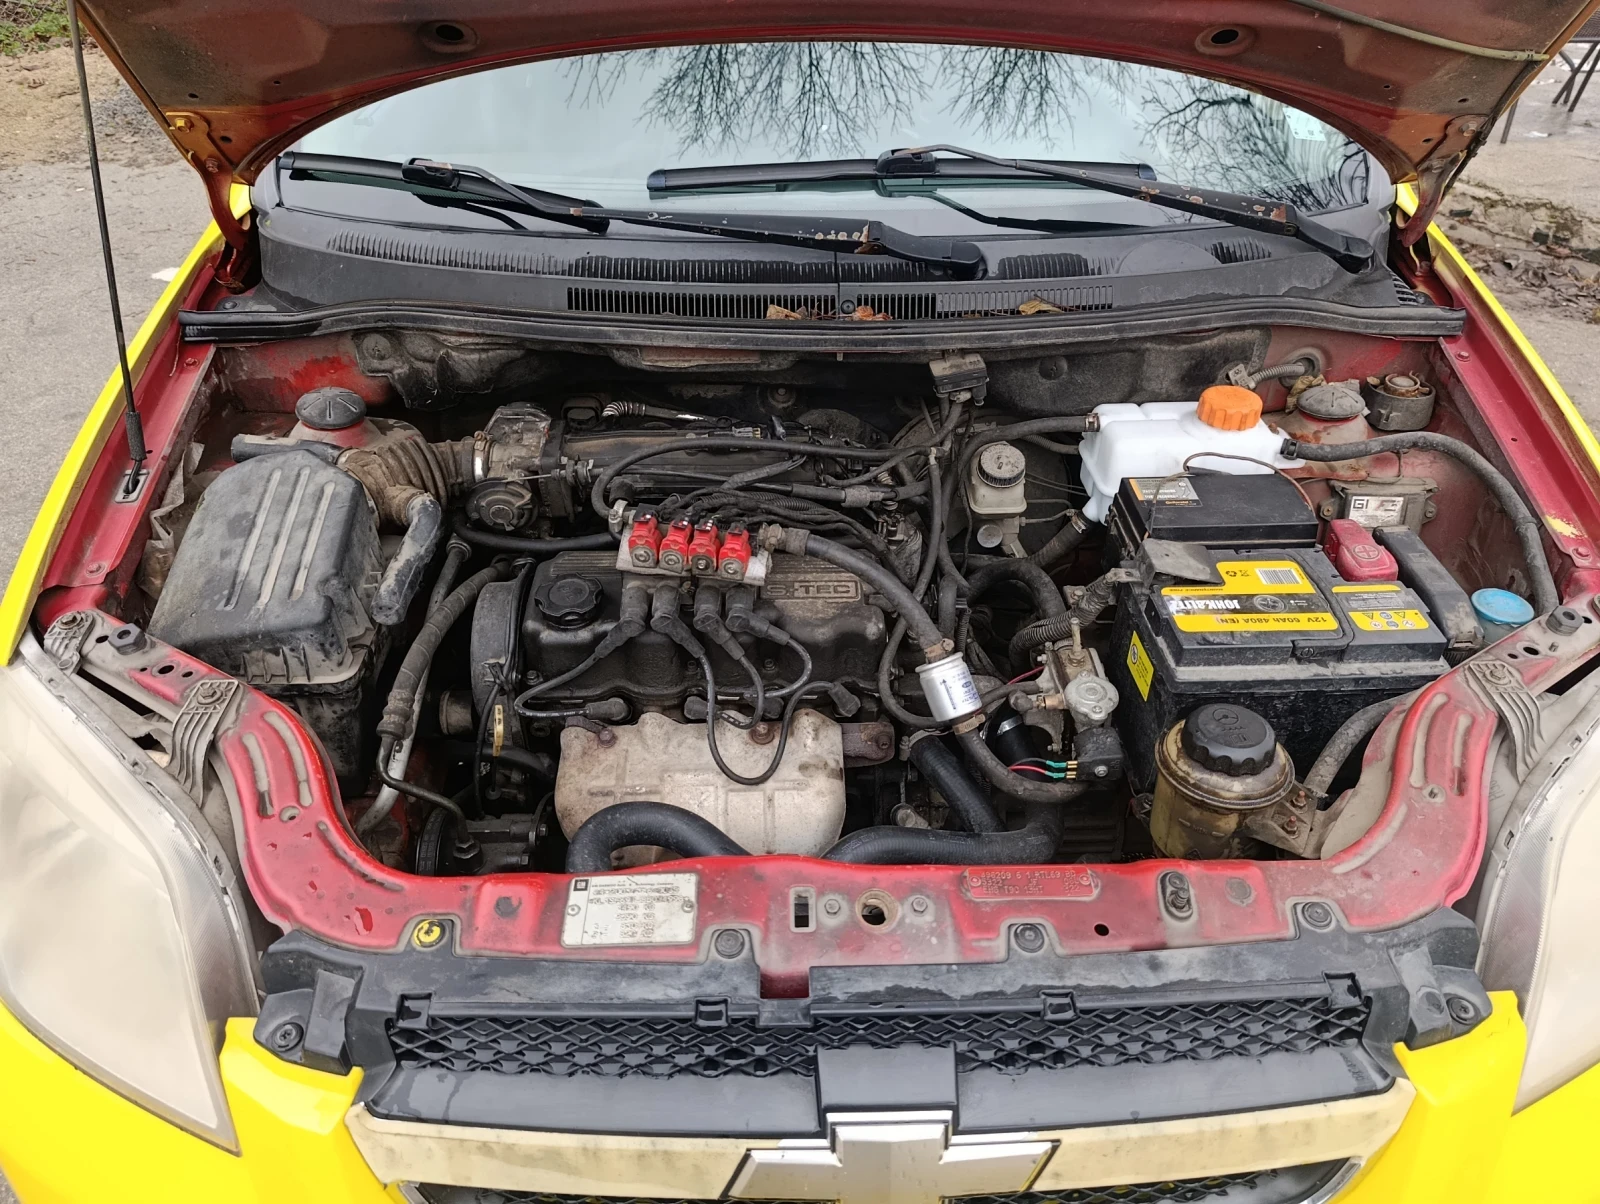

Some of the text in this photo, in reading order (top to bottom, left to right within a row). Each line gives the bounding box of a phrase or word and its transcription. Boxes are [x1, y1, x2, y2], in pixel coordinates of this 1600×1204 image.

[767, 584, 850, 596] S-TEC
[1272, 616, 1301, 624] 60Ah
[1306, 616, 1328, 624] 12V
